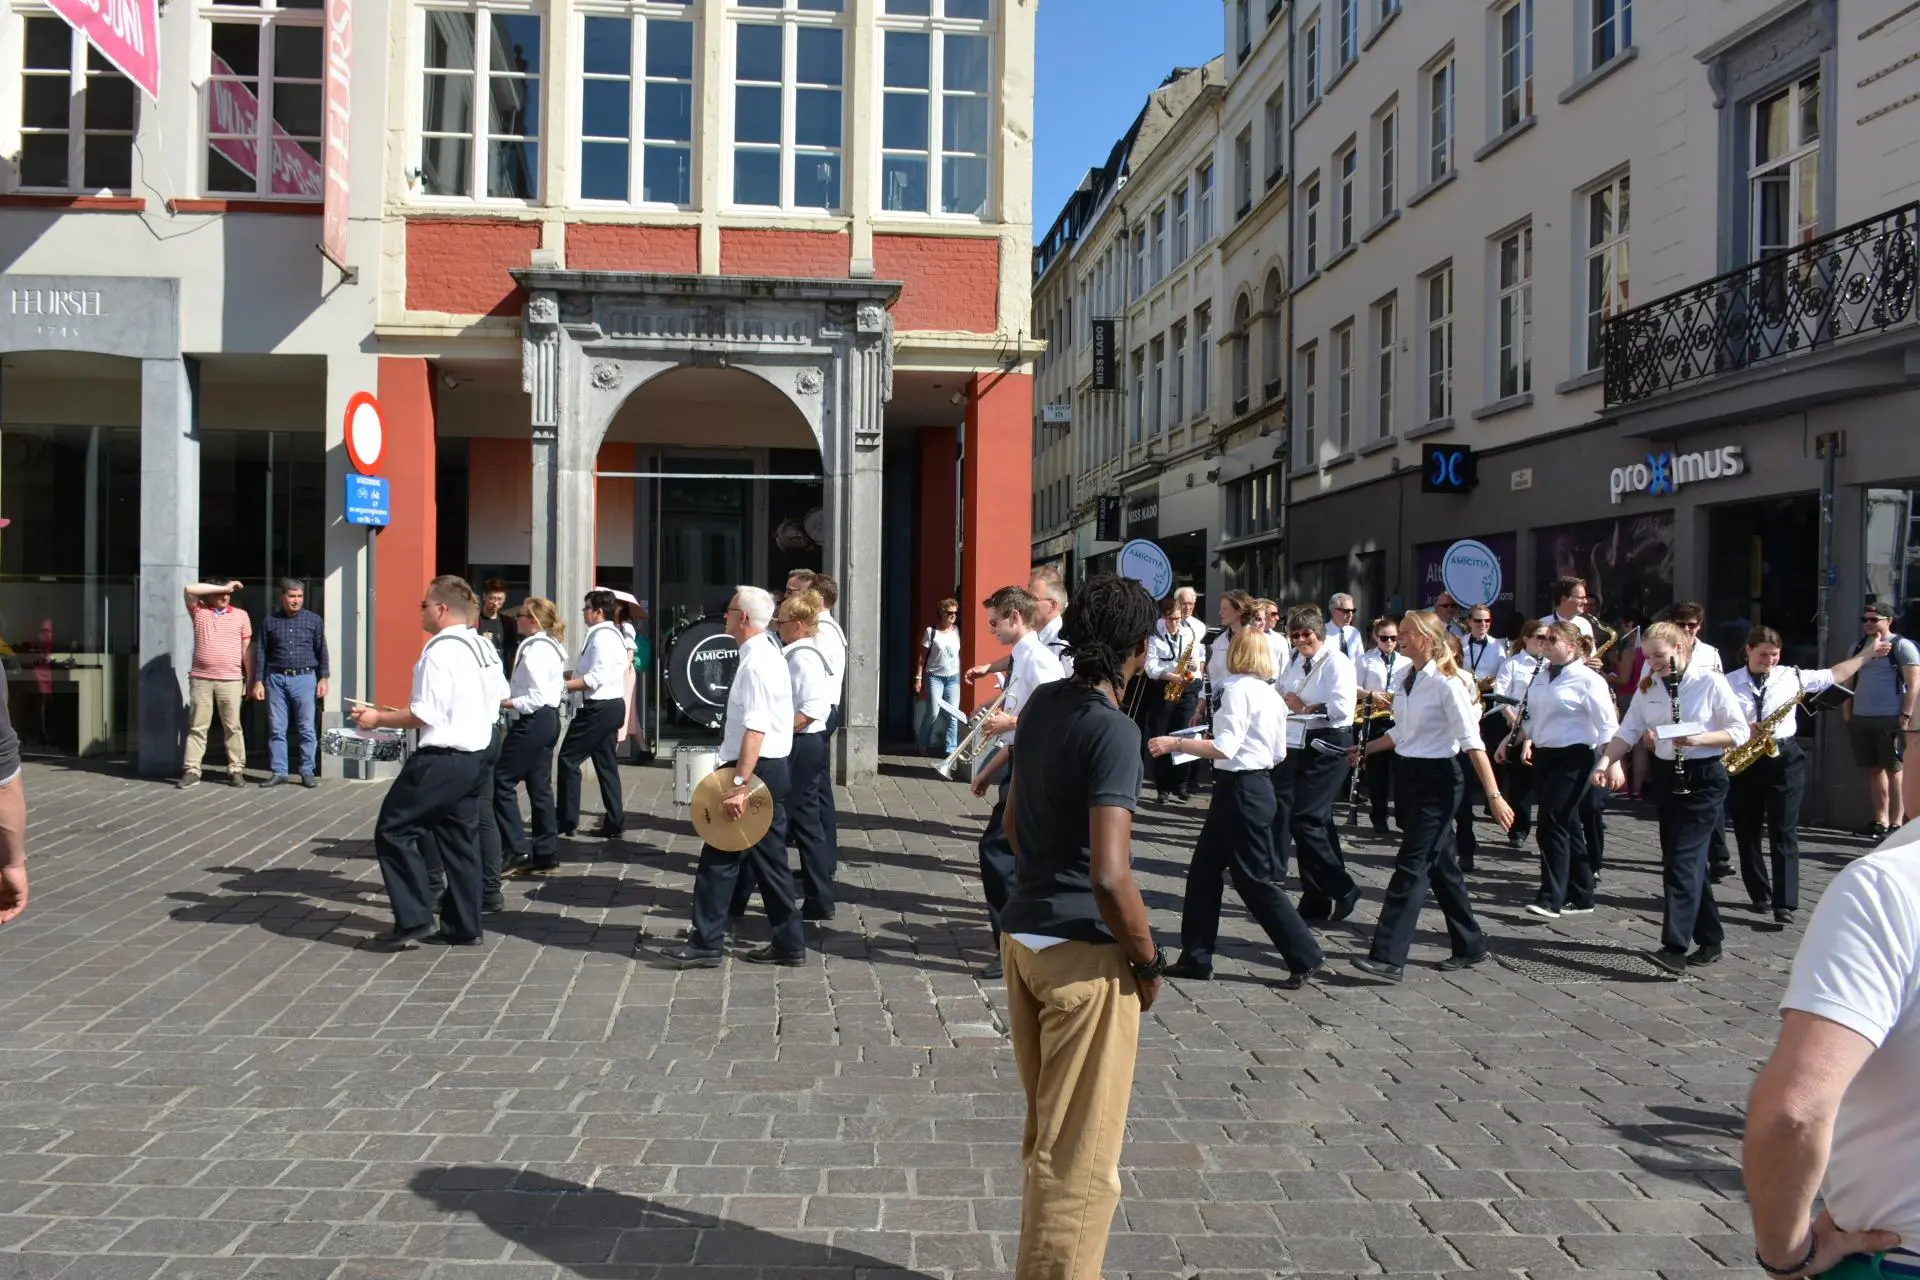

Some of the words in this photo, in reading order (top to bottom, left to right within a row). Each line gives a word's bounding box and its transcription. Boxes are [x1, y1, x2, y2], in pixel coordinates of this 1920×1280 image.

[11, 289, 109, 317] HEURSEL
[1096, 325, 1104, 356] KADO
[1096, 359, 1104, 385] MISS
[1128, 509, 1141, 524] MISS
[1142, 504, 1158, 520] KADO
[1128, 548, 1164, 568] AMICITIA
[1450, 555, 1490, 569] AMICITIA
